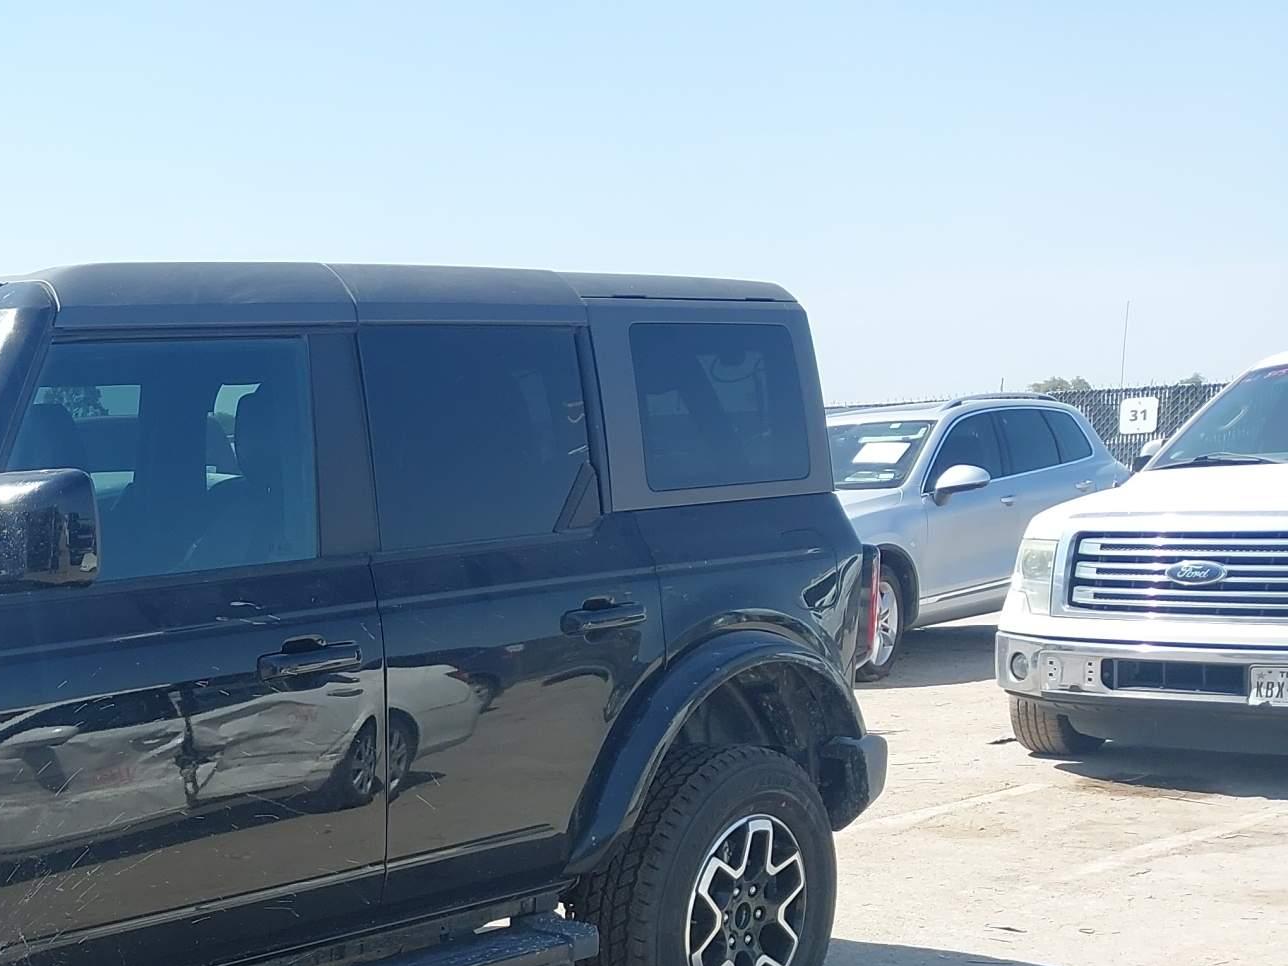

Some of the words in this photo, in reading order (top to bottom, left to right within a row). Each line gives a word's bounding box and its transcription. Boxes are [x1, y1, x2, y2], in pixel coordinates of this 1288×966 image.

[1128, 409, 1147, 421] 31
[1176, 565, 1211, 578] Ford
[1279, 670, 1288, 678] T
[1255, 681, 1285, 698] KBX
